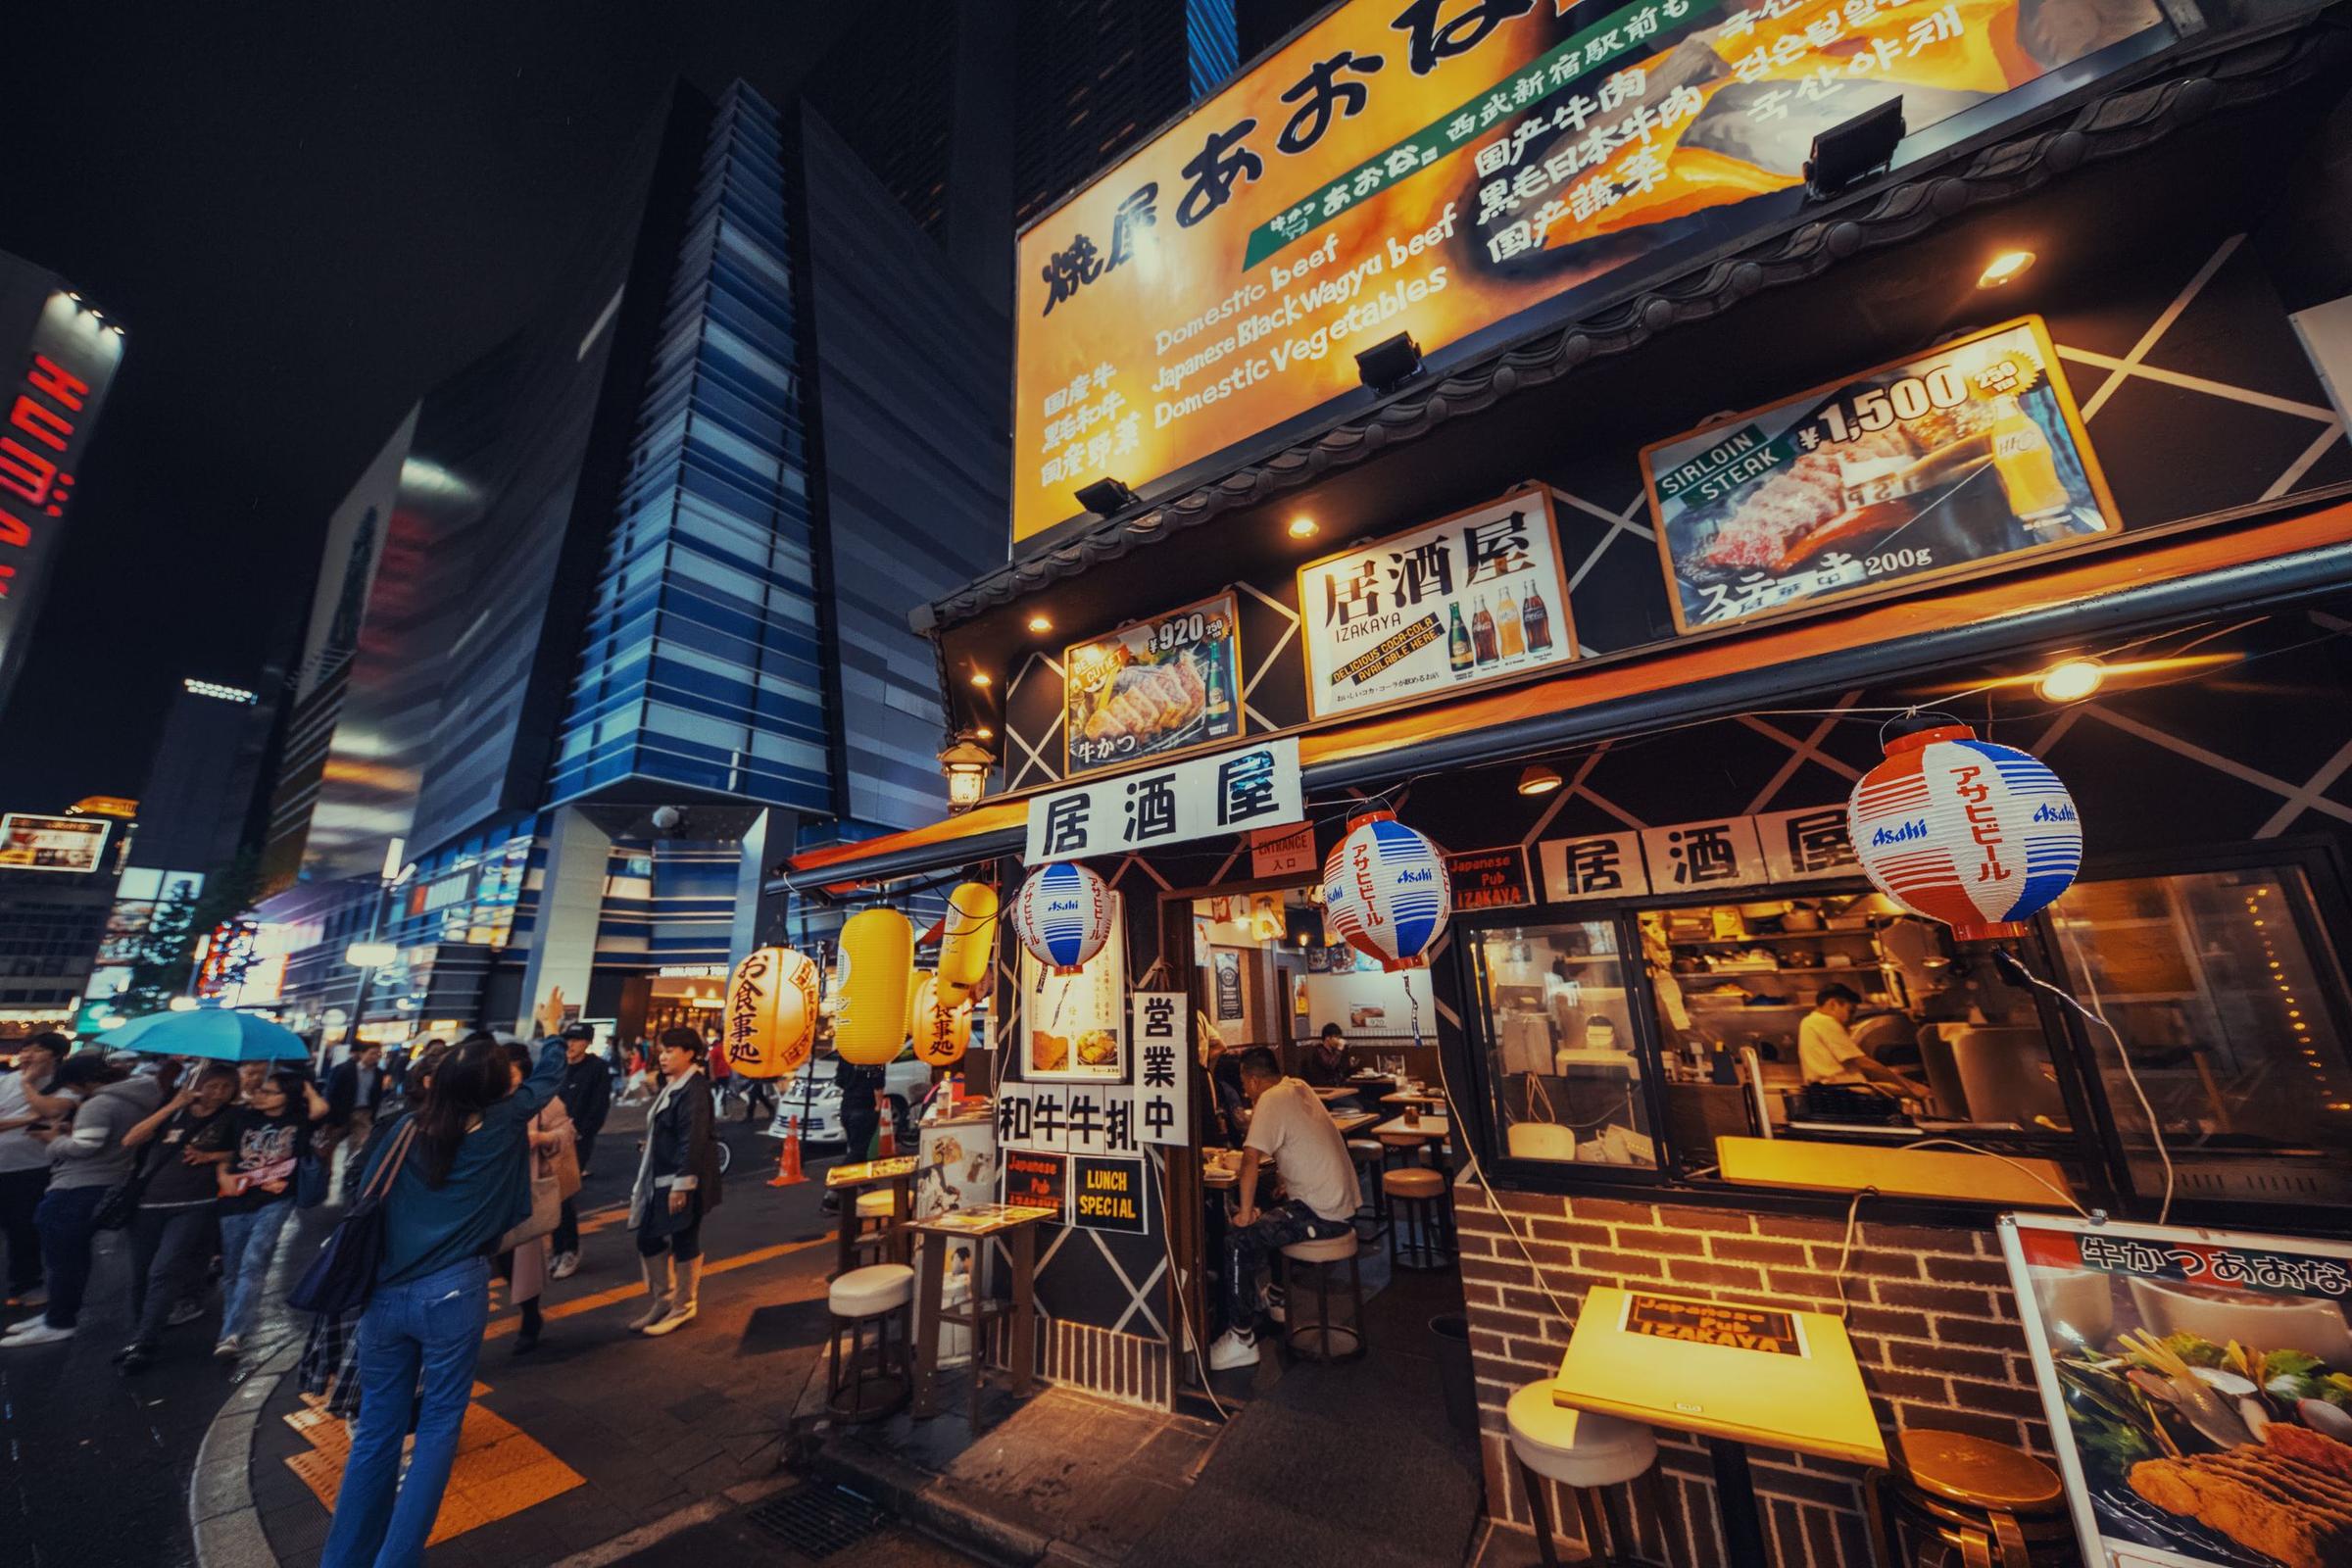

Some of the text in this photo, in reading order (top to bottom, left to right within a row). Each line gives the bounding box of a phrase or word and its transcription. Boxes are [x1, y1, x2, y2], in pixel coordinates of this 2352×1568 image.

[1732, 0, 1911, 83] 검은털일
[1474, 69, 1646, 178] 国产牛肉
[1487, 143, 1668, 264] 国产蔬菜
[1152, 202, 1457, 392] Japanese Black Wagyu beef
[1154, 233, 1340, 356] Domestic beef
[1153, 266, 1447, 429] Domestic Vegetables
[1974, 361, 2019, 391] 250
[1797, 365, 1969, 452] ¥1,500
[1662, 432, 1754, 495] SIRLOIN
[1703, 448, 1781, 501] STEAK
[1325, 510, 1537, 629] 居酒屋
[1865, 547, 1933, 577] 200g
[1148, 613, 1204, 655] ¥920
[1205, 619, 1223, 635] 250
[1334, 643, 1380, 682] DELICIOUS
[1382, 617, 1434, 653] COCA-COLA
[1337, 612, 1401, 643] IZAKAYA
[1358, 643, 1410, 681] AVAILABLE
[1411, 630, 1437, 652] HERE
[1079, 735, 1136, 763] 牛かつ
[1043, 750, 1280, 857] 居酒屋
[1949, 765, 2011, 882] アサヒビール
[2033, 803, 2077, 823] Asahi
[1258, 834, 1308, 856] ENTRANCE
[1568, 809, 1854, 896] 居酒屋
[1872, 818, 1928, 847] Asahi
[1273, 858, 1296, 871] 入口
[1352, 843, 1384, 927] アサヒビール
[1397, 868, 1432, 884] Asahi
[1449, 856, 1511, 873] Japanese
[1481, 872, 1505, 886] Pub
[1024, 881, 1040, 947] アサヒビール
[1048, 900, 1079, 912] Asahi
[1088, 876, 1103, 941] アサヒビール
[1457, 886, 1521, 908] IZAKAYA
[730, 955, 769, 1065] お食事処
[928, 990, 956, 1056] 食事処
[1144, 998, 1175, 1139] 営業中
[1008, 1152, 1057, 1176] Japanese
[1030, 1178, 1051, 1195] Pub
[1087, 1169, 1127, 1192] LUNCH
[1079, 1195, 1136, 1219] SPECIAL
[2081, 1236, 2351, 1295] 牛かつあおな
[1641, 1298, 1765, 1323] Japanese
[1699, 1316, 1750, 1334] Pub
[1641, 1322, 1782, 1353] IZAKAYA
